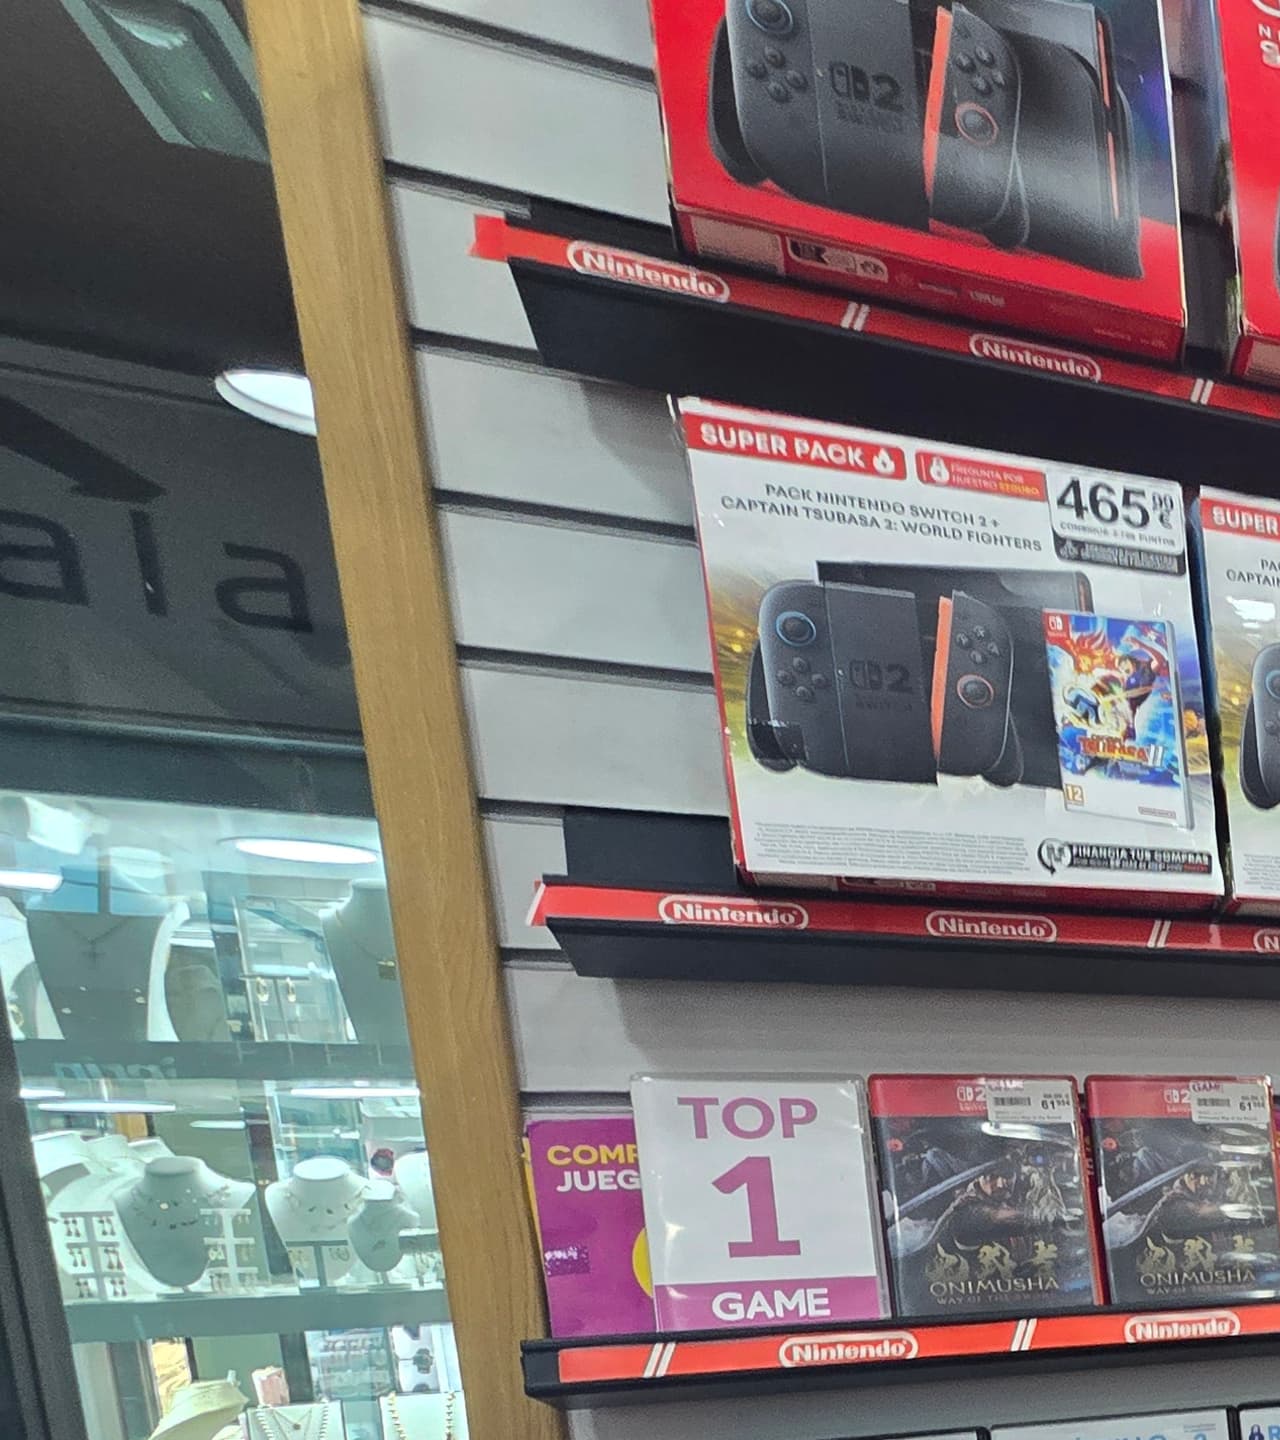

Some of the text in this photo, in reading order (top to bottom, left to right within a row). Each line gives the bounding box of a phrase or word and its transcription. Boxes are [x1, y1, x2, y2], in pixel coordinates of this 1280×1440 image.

[582, 248, 718, 298] Nintendo
[984, 341, 1090, 378] Nintendo
[700, 422, 866, 469] SUPER PACK
[766, 484, 812, 502] PACK
[816, 490, 906, 516] NINTENDO
[909, 504, 975, 526] SWITCH
[1056, 477, 1151, 529] 465
[1212, 506, 1279, 534] SUPER
[721, 496, 800, 518] CAPTAIN
[802, 506, 881, 531] TSUBASA
[901, 518, 963, 541] WORLD
[966, 529, 1043, 552] FIGHTERS
[673, 899, 796, 926] Nintendo
[938, 915, 1049, 939] Nintendo
[678, 1097, 818, 1140] TOP
[712, 1156, 801, 1259] 1
[929, 1277, 1060, 1297] ONIMUSHA
[1140, 1270, 1257, 1289] ONIMUSHA
[711, 1288, 832, 1322] GAME
[1137, 1317, 1231, 1340] Nintendo
[791, 1340, 906, 1361] Nintendo
